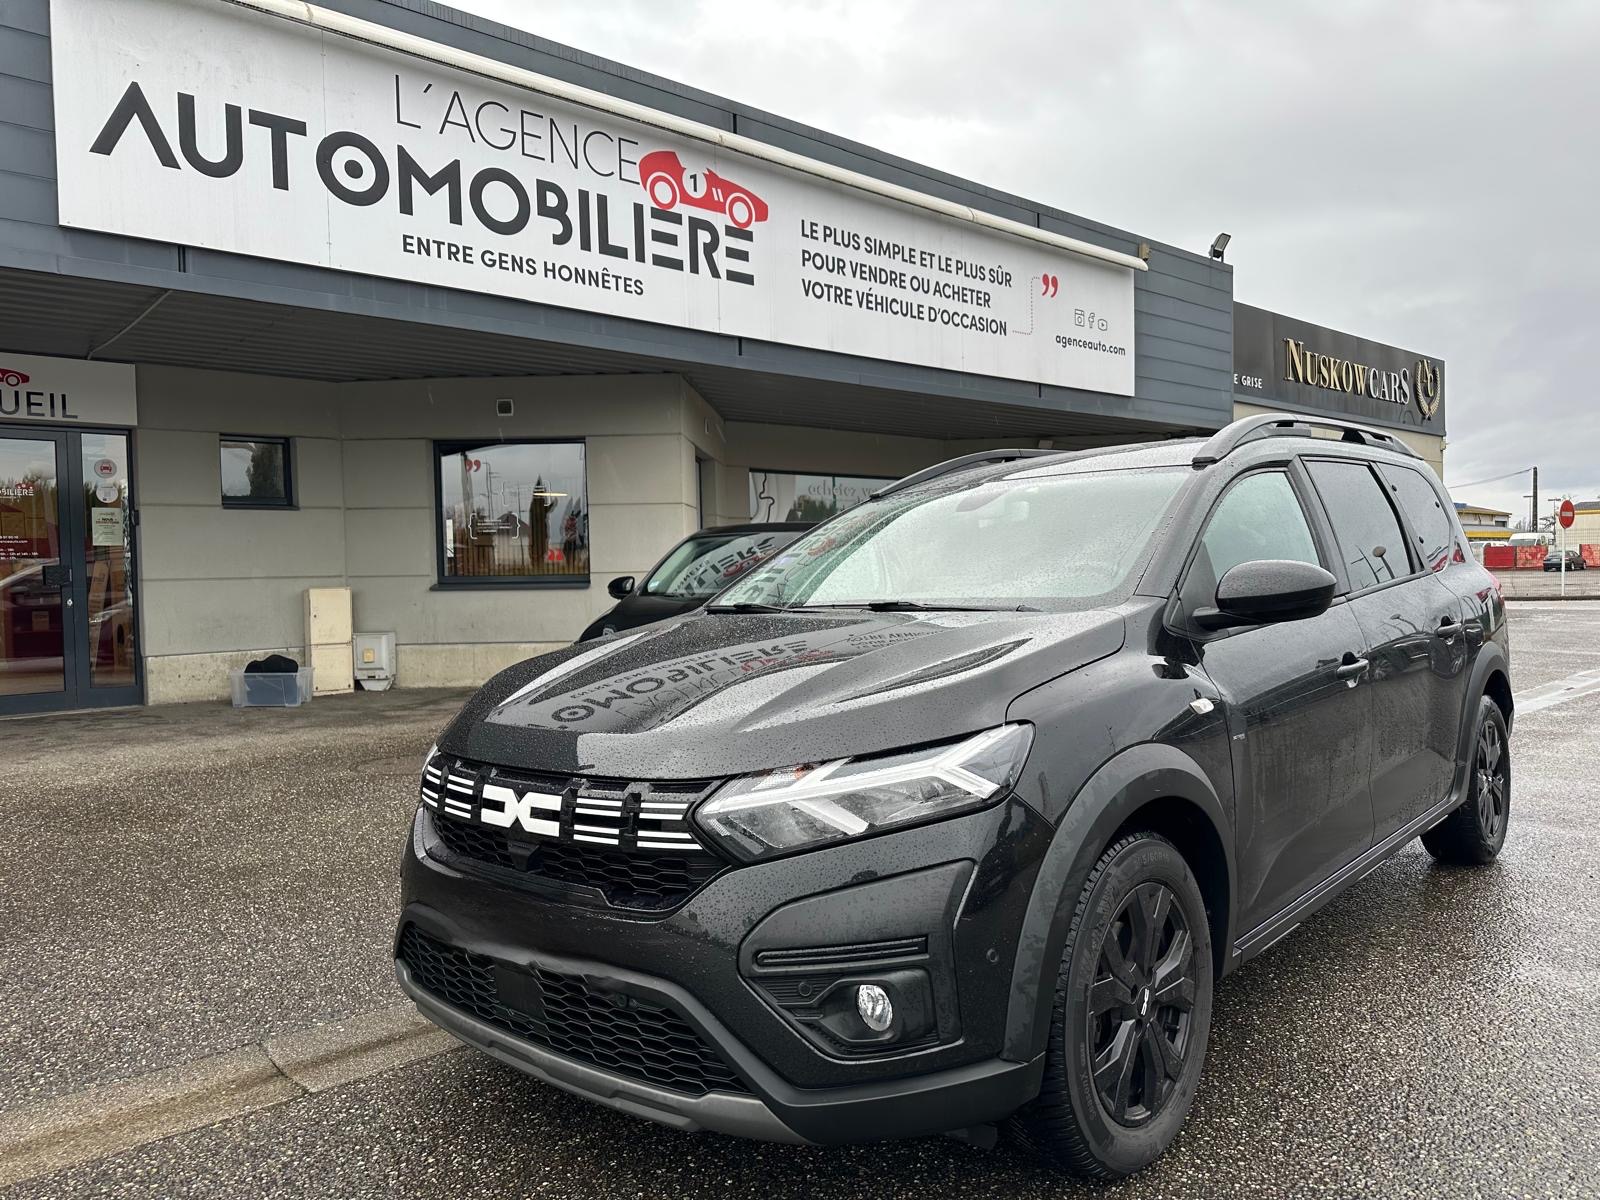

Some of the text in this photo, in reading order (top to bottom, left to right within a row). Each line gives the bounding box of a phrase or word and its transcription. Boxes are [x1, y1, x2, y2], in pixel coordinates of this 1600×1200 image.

[395, 74, 641, 186] L'AGENCE
[689, 173, 699, 193] 1
[402, 234, 645, 296] ENTRE GENS HONNÊTES
[801, 219, 1012, 288] LE PLUS SIMPLE ET LE PLUS SÛR
[801, 250, 991, 309] POUR VENDRE OU ACHETER
[801, 278, 1008, 337] VOTRE VÉHICULE D'OCCASION
[1055, 334, 1126, 356] agenceauto.com
[1241, 375, 1263, 389] GRISE
